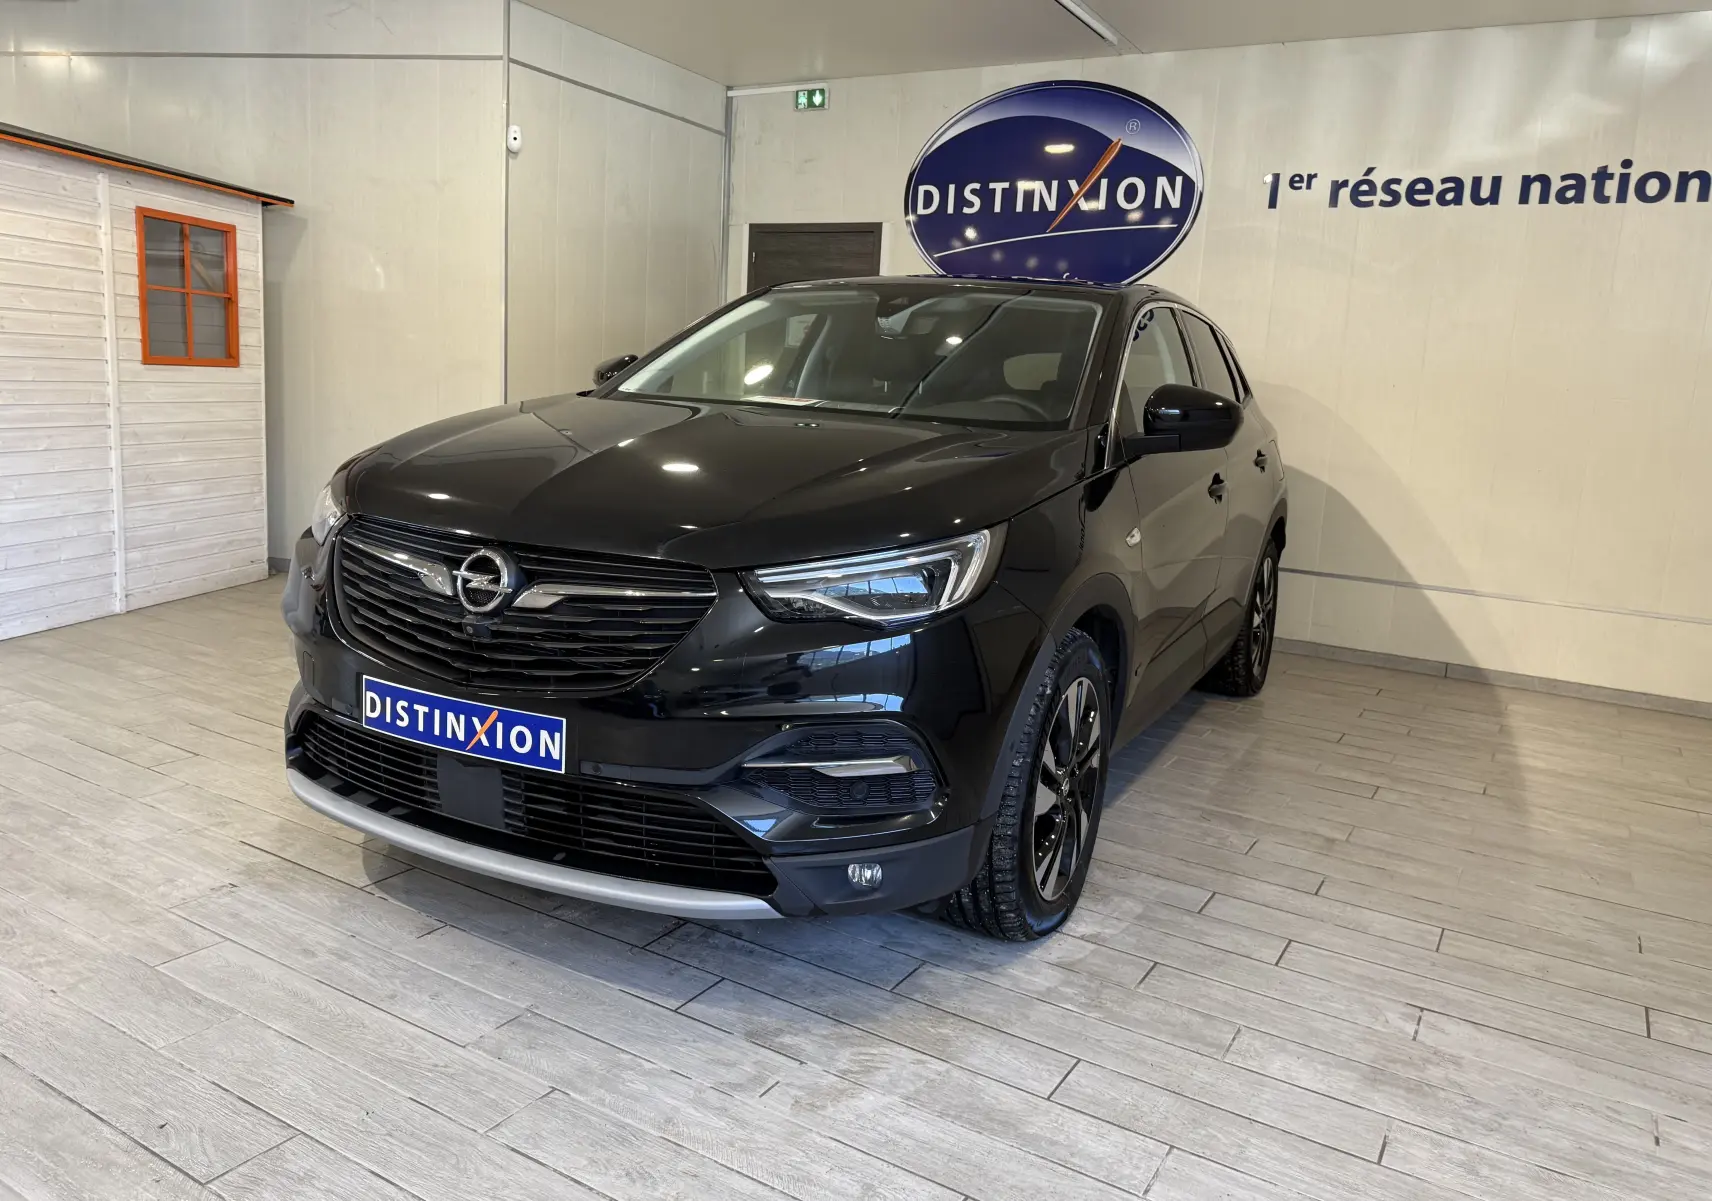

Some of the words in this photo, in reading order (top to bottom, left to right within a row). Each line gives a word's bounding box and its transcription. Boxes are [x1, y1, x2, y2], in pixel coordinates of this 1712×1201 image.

[916, 176, 1184, 233] DISTINXION
[1328, 167, 1503, 208] réseau
[365, 690, 561, 760] DISTINXION
